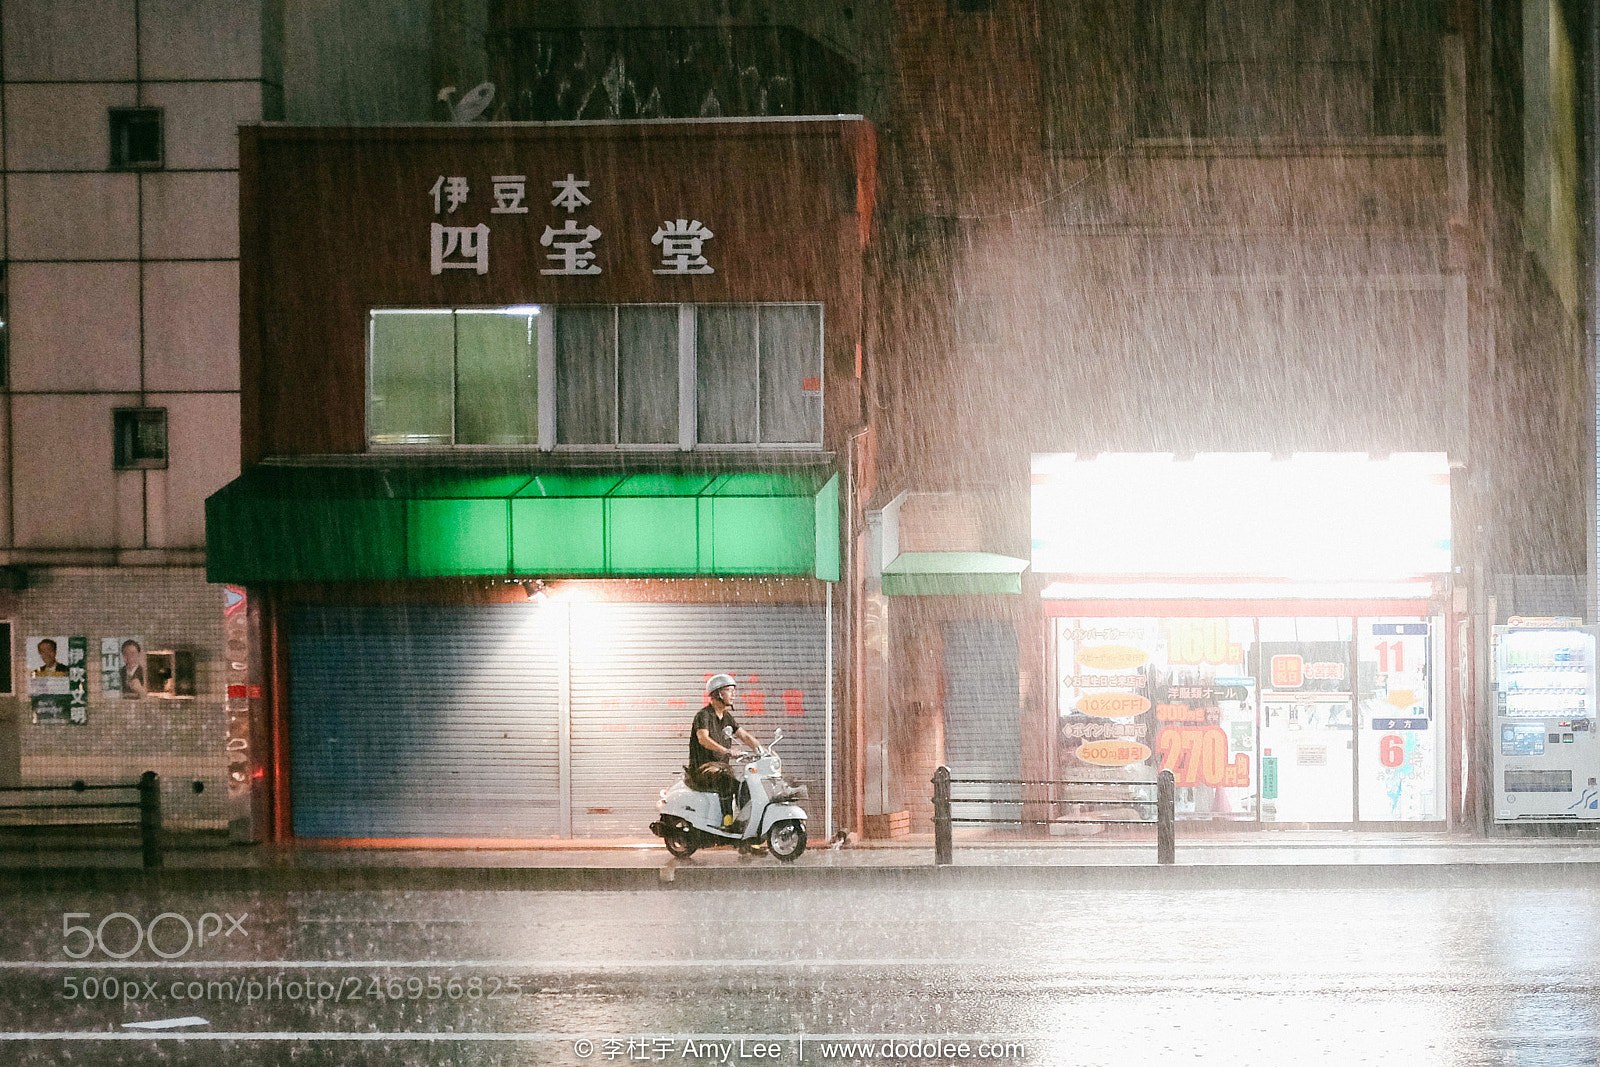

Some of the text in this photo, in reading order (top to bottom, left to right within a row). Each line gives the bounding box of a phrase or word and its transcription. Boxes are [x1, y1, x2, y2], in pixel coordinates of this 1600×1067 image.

[429, 174, 592, 214] 伊豆本
[430, 218, 715, 276] 四宝堂
[1374, 641, 1404, 672] 11
[1168, 687, 1237, 699] 洋服類オール
[1084, 698, 1143, 711] 10%OFF!
[1082, 747, 1144, 761] 500円割引!
